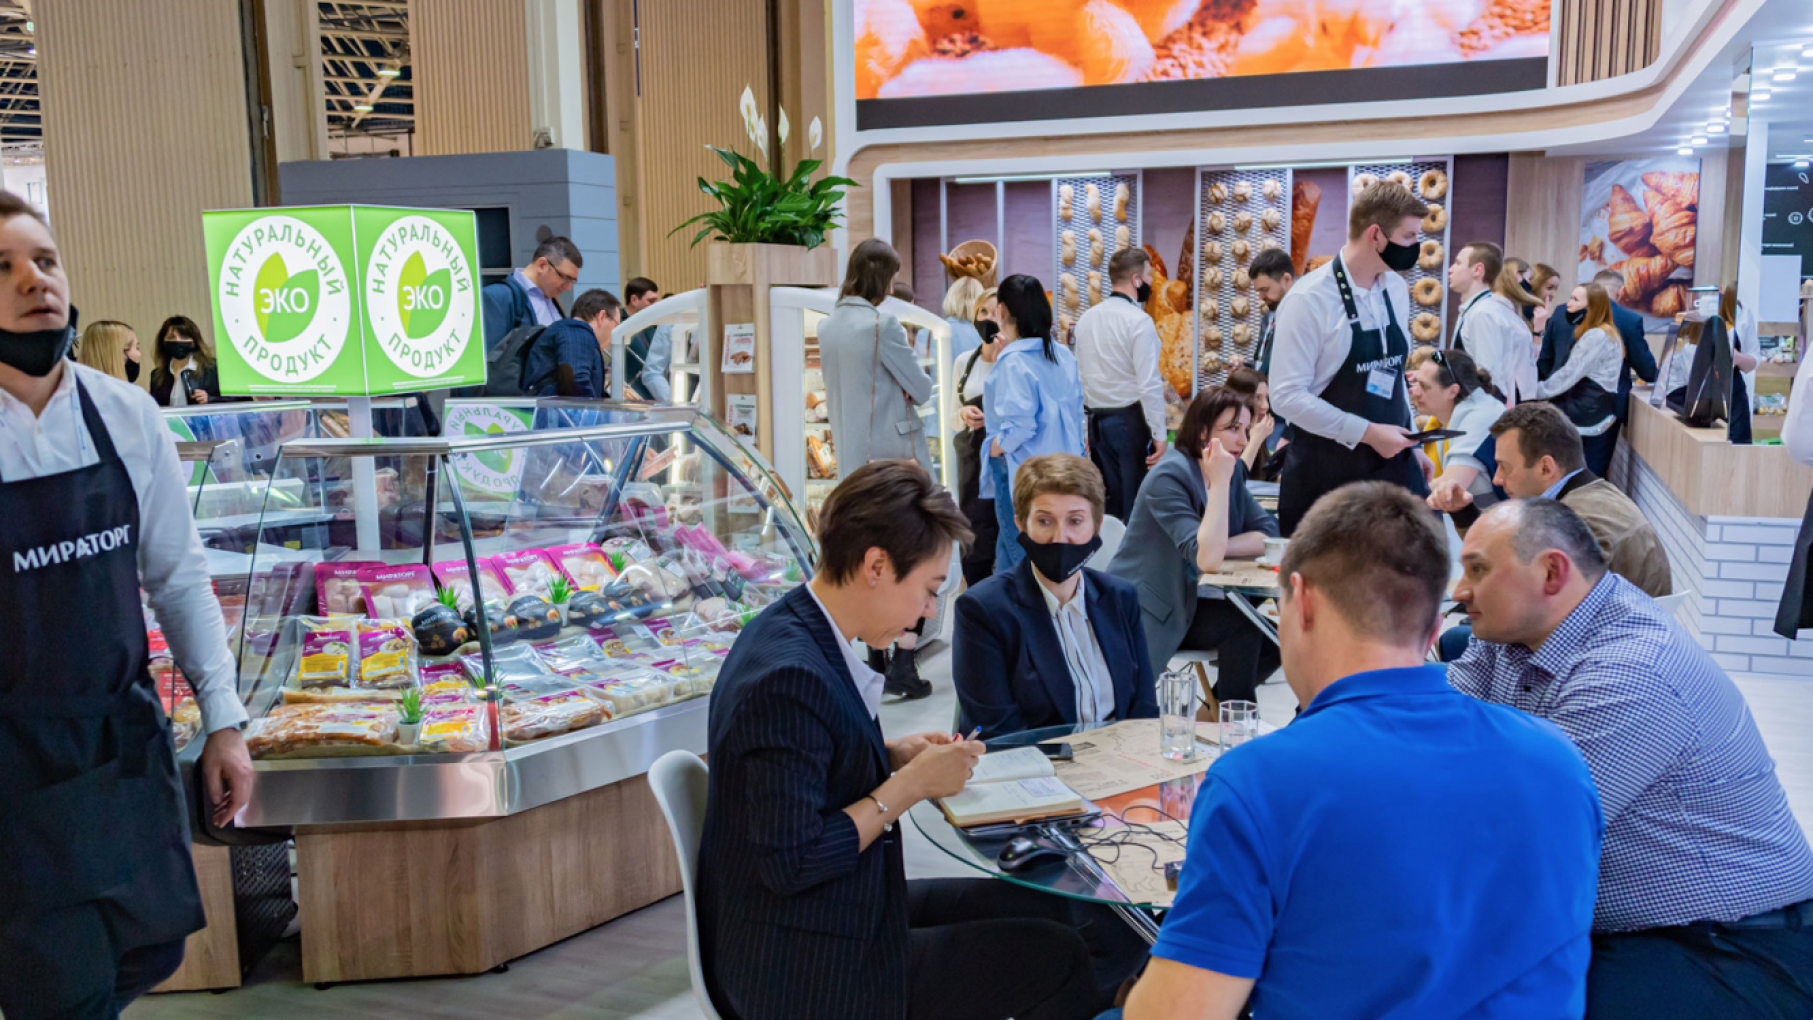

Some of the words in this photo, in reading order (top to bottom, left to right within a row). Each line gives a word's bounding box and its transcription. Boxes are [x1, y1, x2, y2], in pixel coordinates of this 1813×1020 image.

[226, 223, 344, 297] НАТУРАЛЬНЫЙ
[372, 223, 470, 294] НАТУРАЛЬНЫЙ
[259, 287, 310, 314] ЭКО
[402, 285, 444, 310] ЭКО
[243, 333, 332, 376] ПРОДУКТ
[388, 329, 461, 371] ПРОДУКТ
[13, 524, 131, 573] МИРАТОРГ
